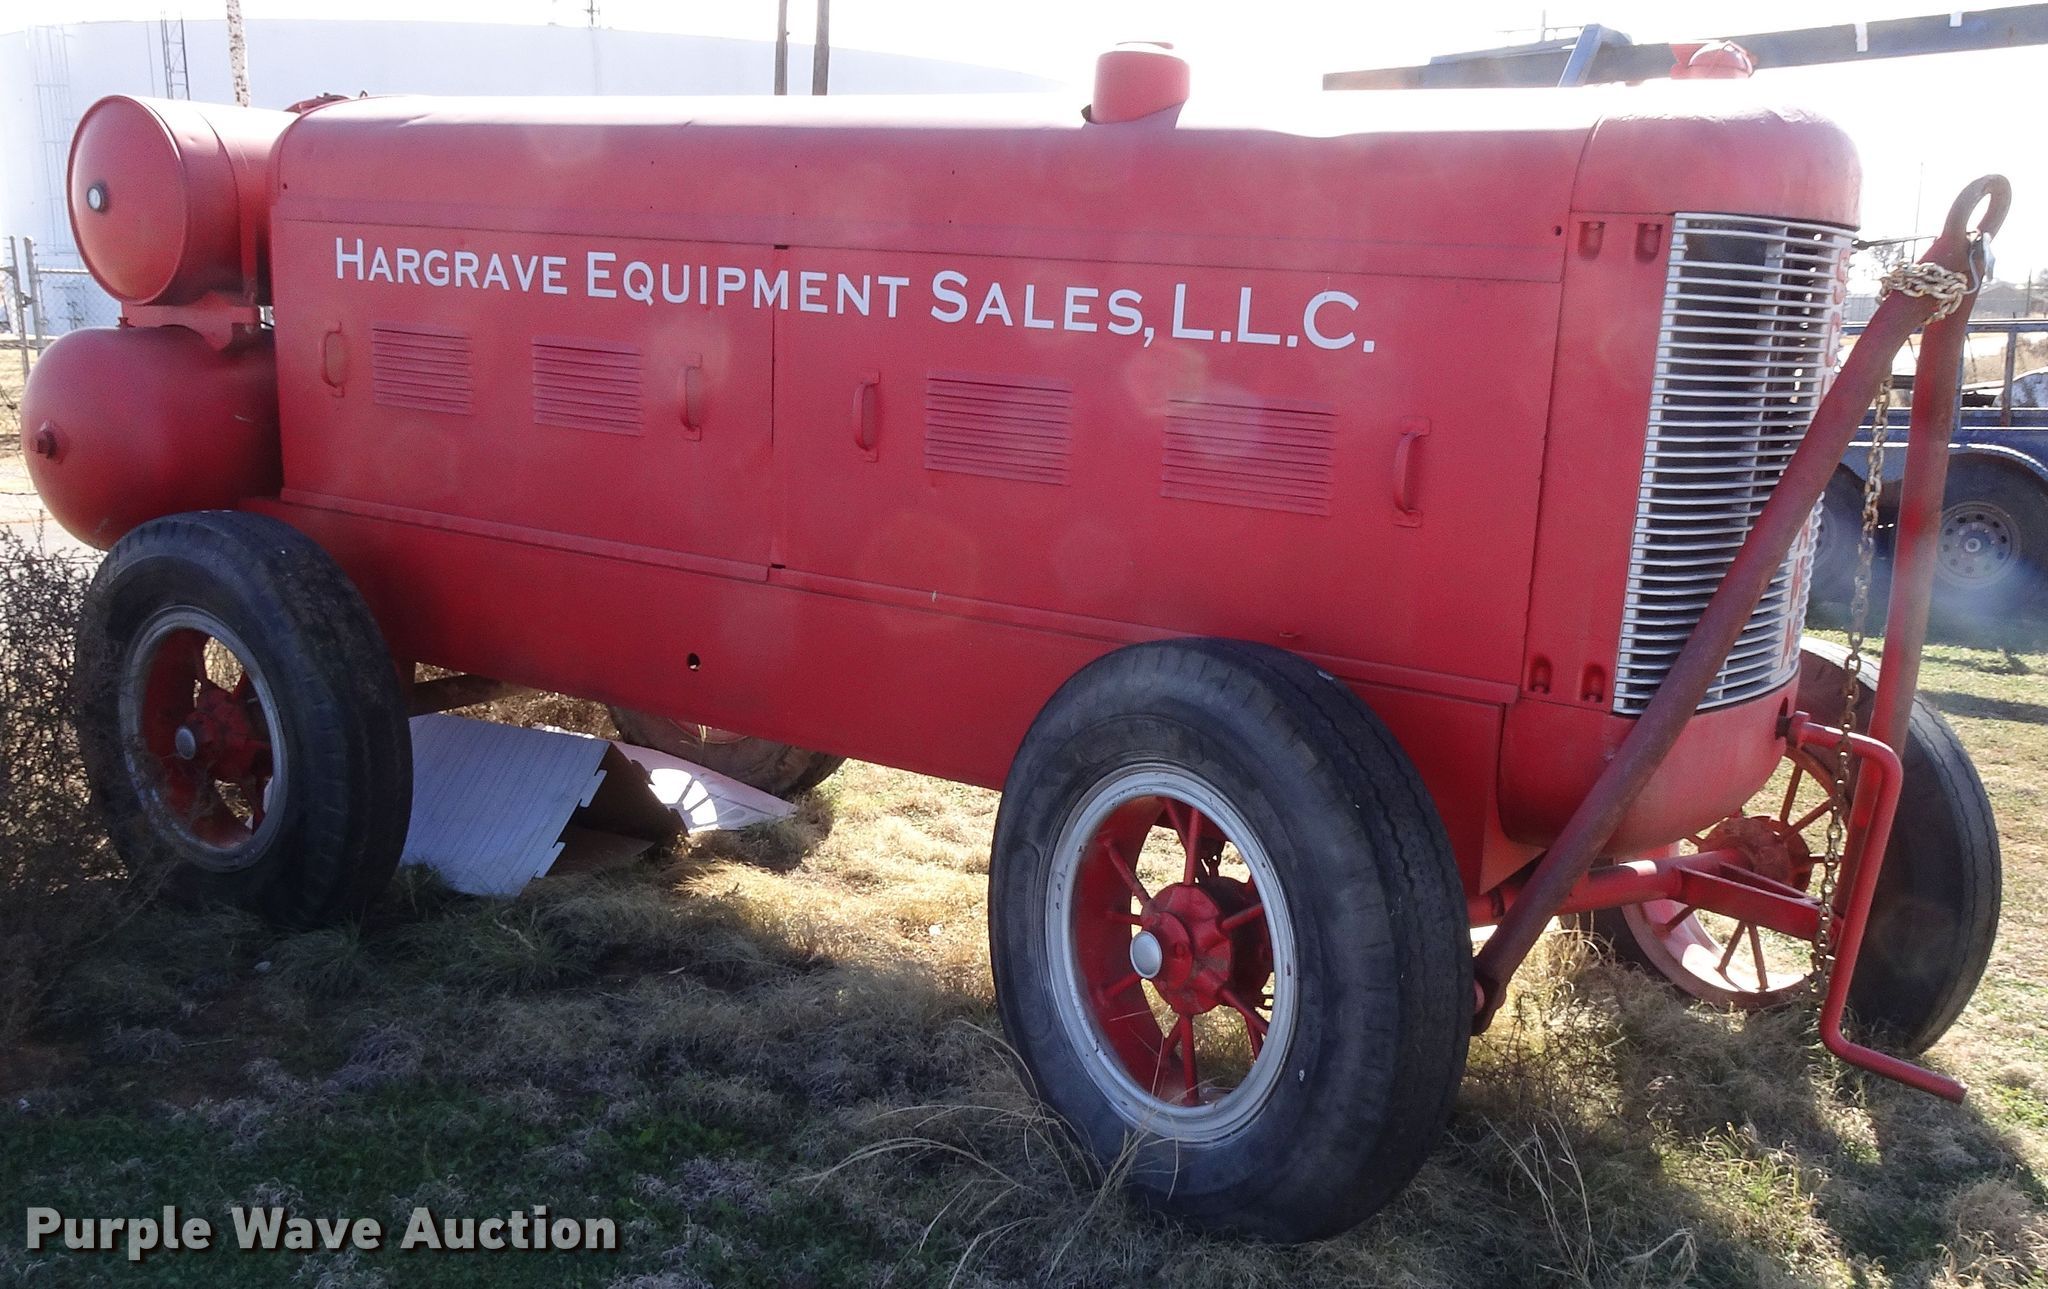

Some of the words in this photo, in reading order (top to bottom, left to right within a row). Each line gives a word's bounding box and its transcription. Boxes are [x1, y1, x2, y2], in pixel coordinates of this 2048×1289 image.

[335, 237, 568, 295] HARGRAVE
[587, 251, 910, 318] EQUIPMENT
[930, 270, 1155, 348] SALES,
[1171, 276, 1376, 353] L.L.C.
